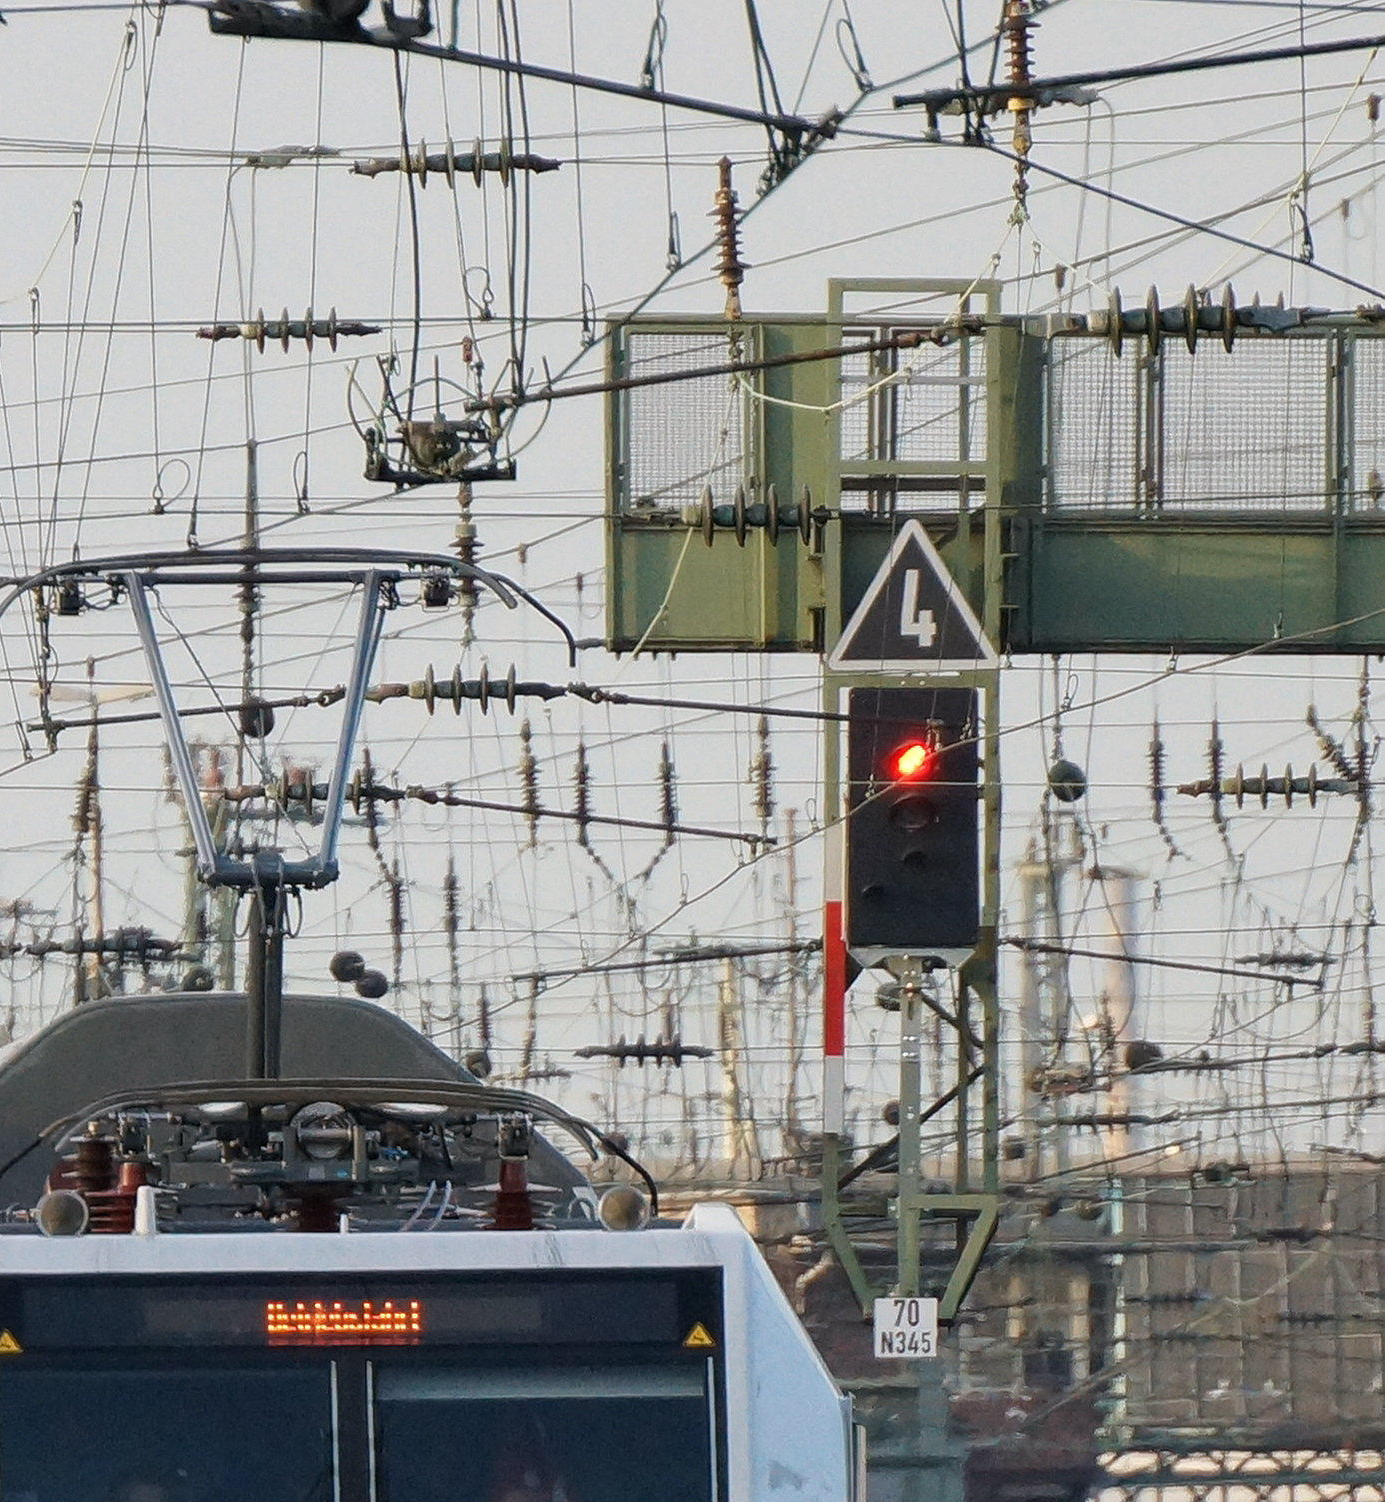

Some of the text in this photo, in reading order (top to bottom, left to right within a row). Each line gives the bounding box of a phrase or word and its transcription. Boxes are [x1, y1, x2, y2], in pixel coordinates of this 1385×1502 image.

[900, 568, 937, 647] 4
[893, 1299, 920, 1327] 70
[880, 1331, 931, 1354] N345
